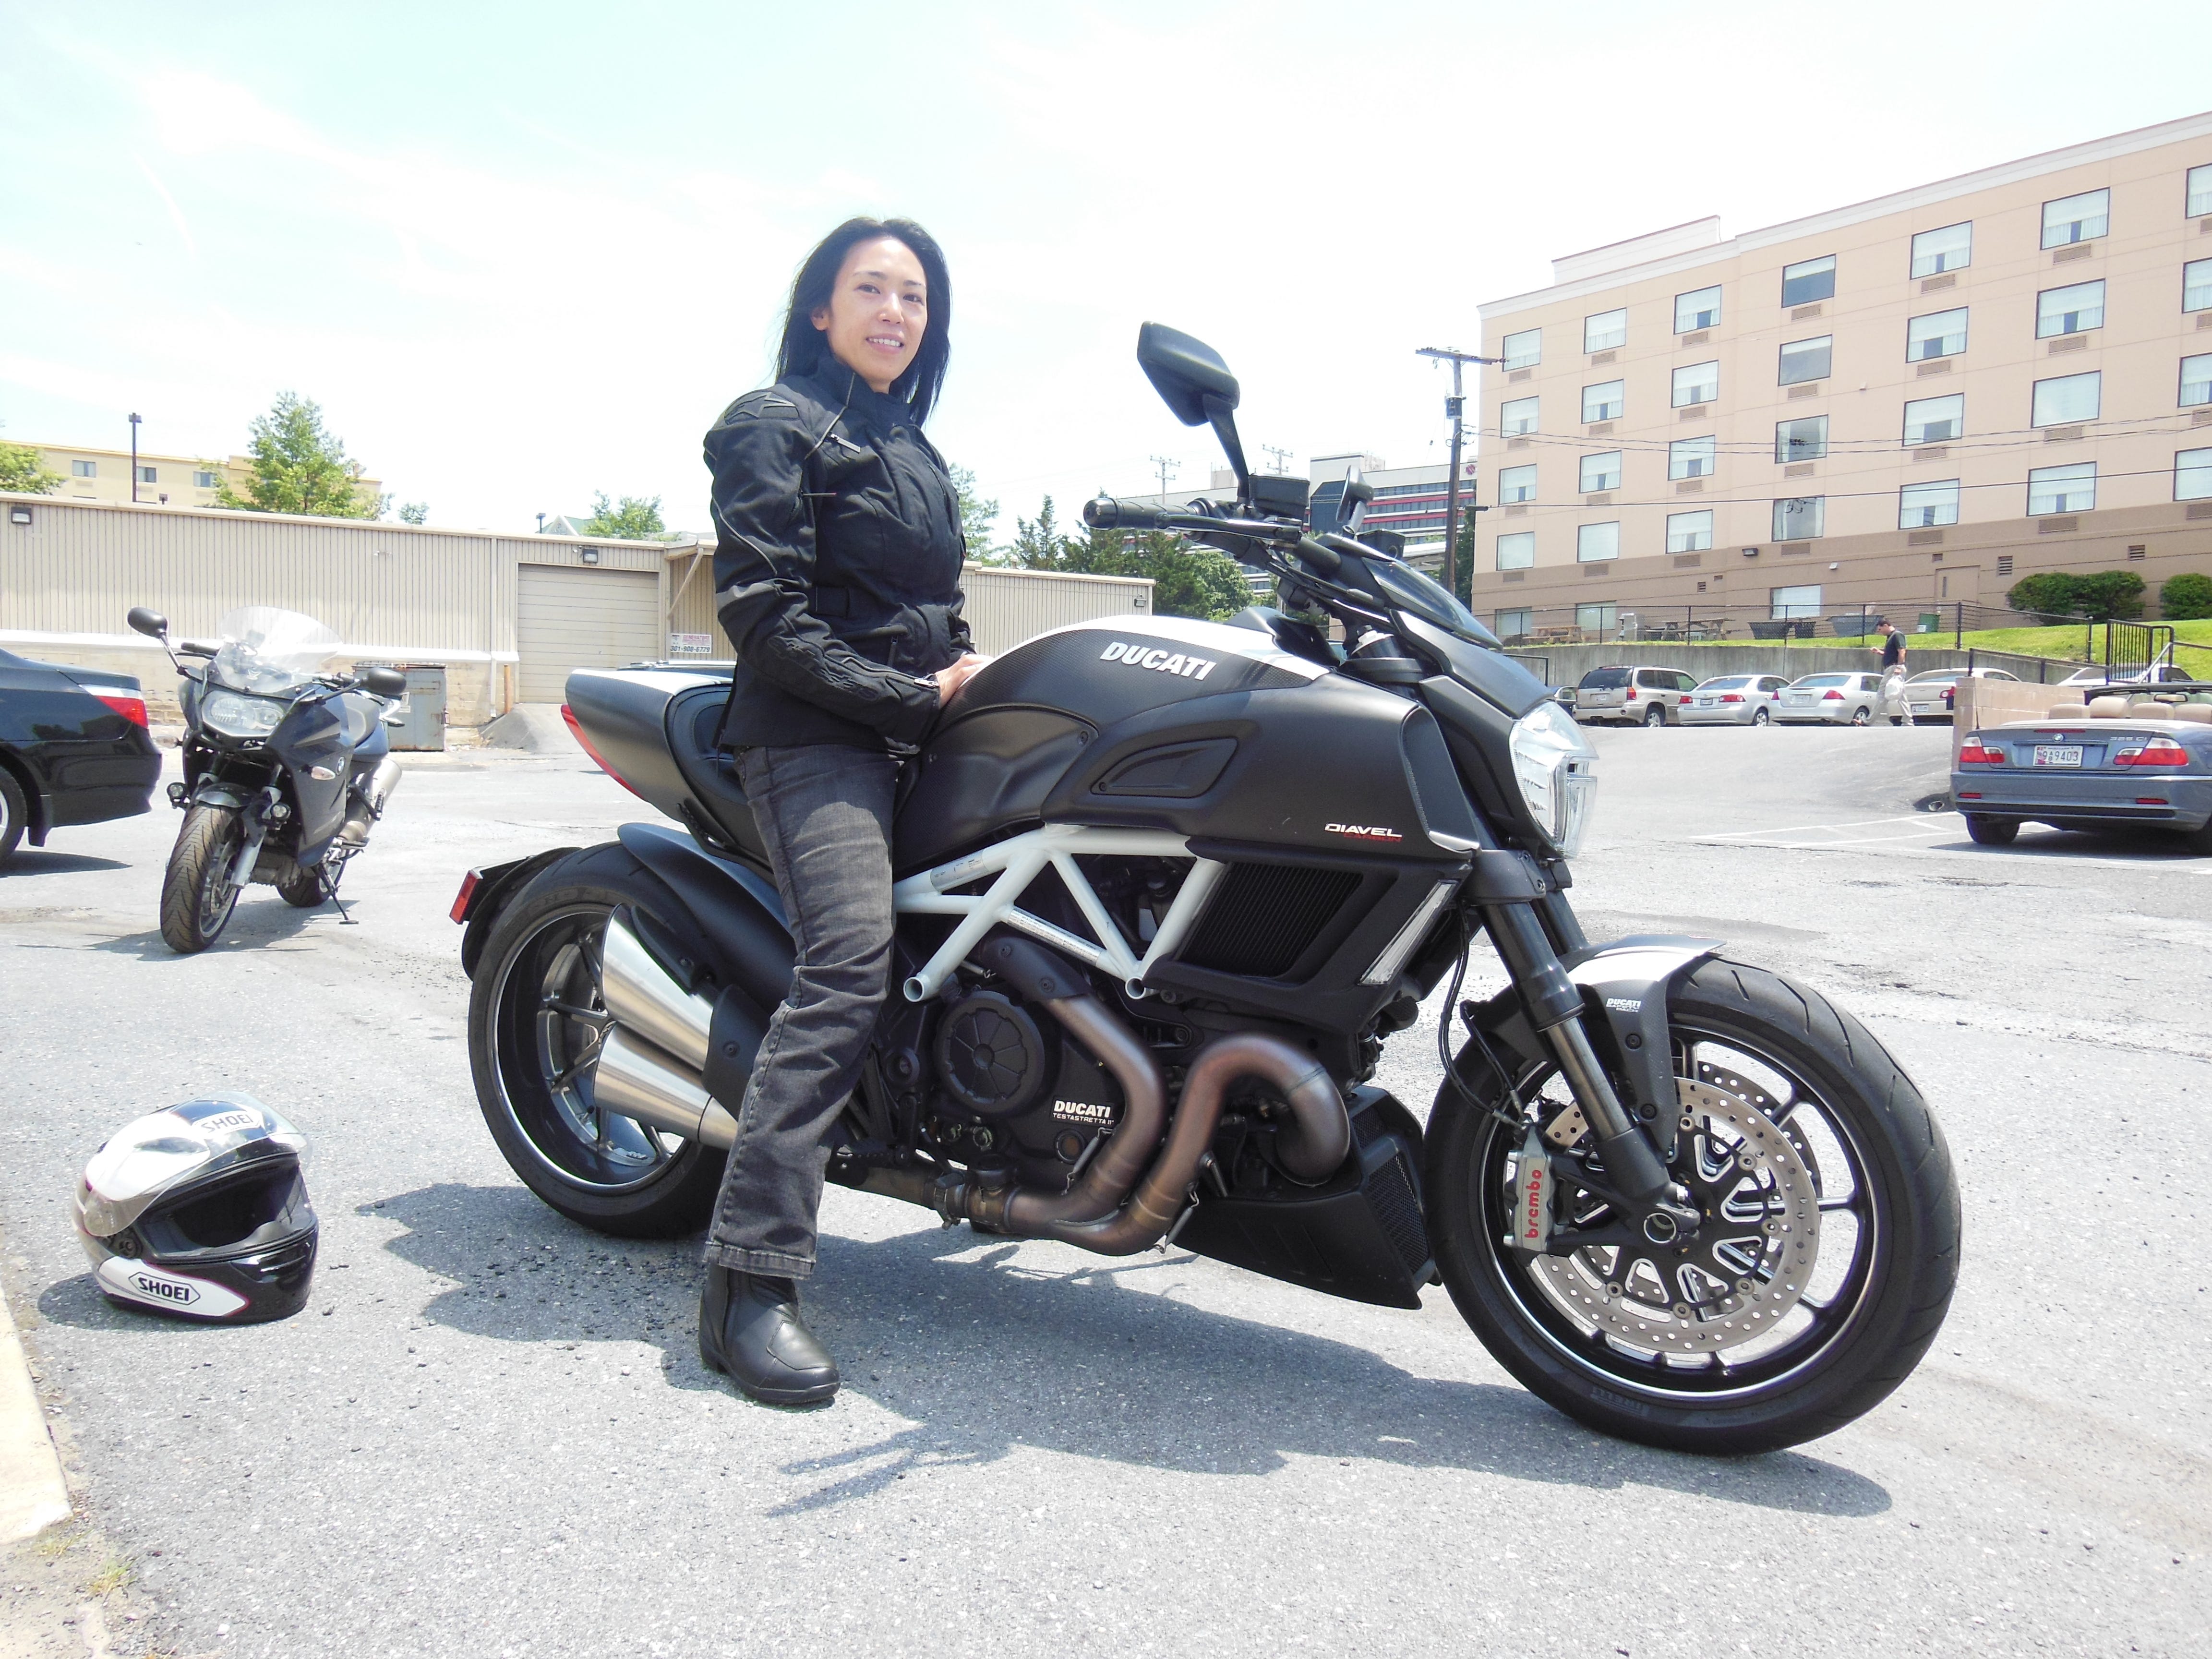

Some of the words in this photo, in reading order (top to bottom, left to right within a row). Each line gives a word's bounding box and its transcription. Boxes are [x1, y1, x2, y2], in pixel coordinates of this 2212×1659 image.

[1100, 642, 1217, 681] DUCATI
[1324, 823, 1403, 838] DIAVEL
[1343, 832, 1403, 842] CARBON
[1606, 998, 1642, 1007] DUCATI
[1054, 1100, 1111, 1118] DUCATI
[201, 1114, 253, 1133] SHOEI
[1053, 1113, 1106, 1124] TESTASTRETTA
[1524, 1169, 1542, 1238] brembo
[138, 1277, 190, 1301] SHOEI
